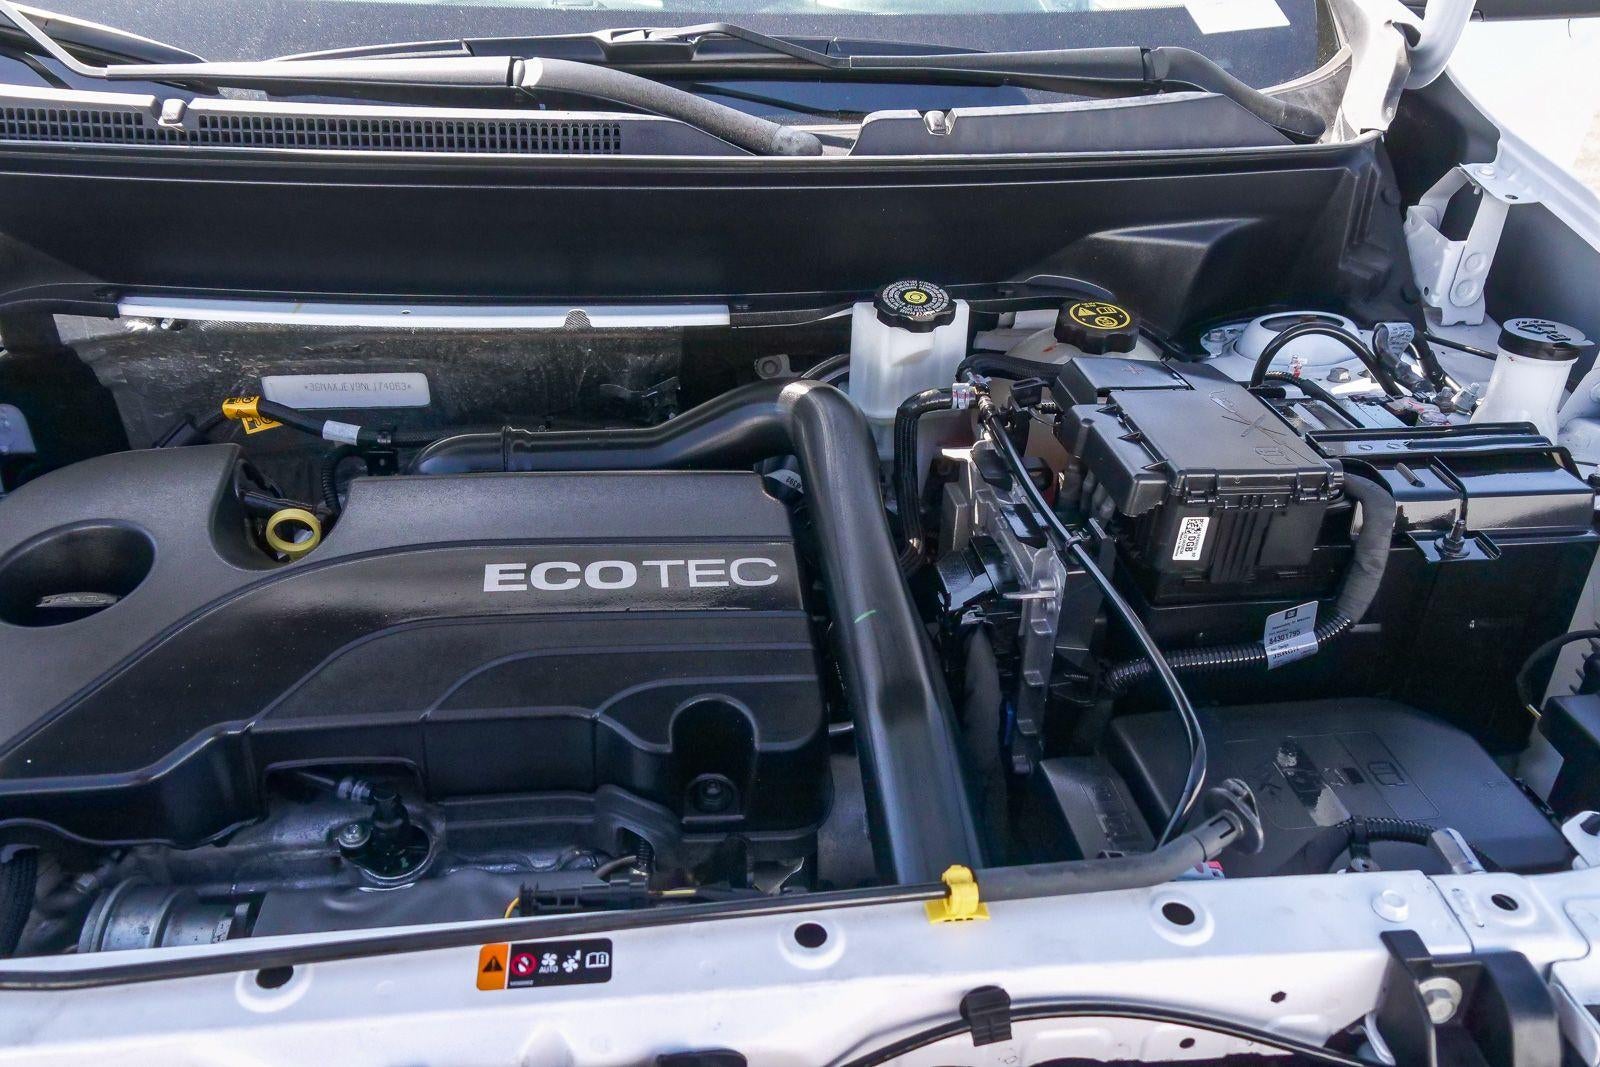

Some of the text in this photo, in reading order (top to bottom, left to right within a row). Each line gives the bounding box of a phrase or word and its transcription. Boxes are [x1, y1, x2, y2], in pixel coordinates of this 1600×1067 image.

[1184, 535, 1197, 552] DGB
[483, 557, 779, 592] ECOTEC
[539, 965, 559, 974] AUTO
